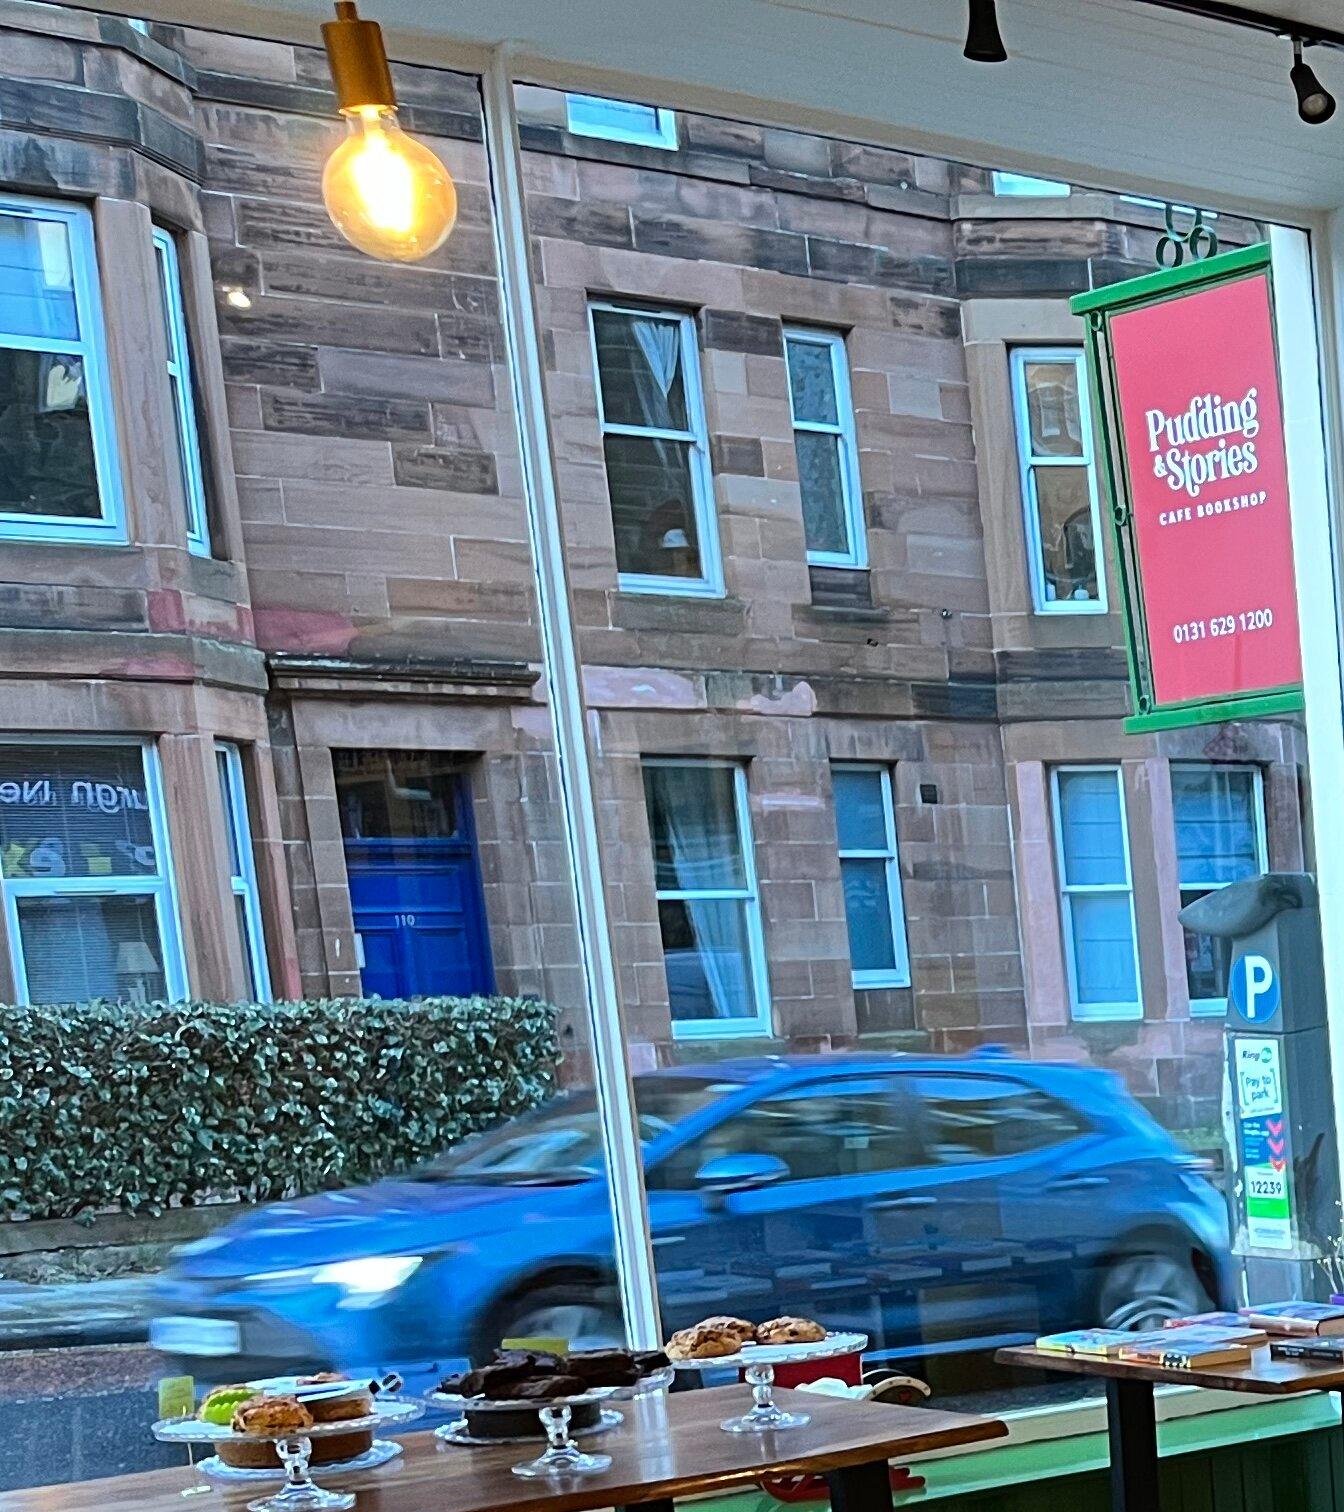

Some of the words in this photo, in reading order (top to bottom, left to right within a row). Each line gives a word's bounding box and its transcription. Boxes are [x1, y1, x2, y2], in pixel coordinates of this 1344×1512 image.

[1145, 387, 1259, 453] Pudding
[1159, 508, 1191, 525] CAFE
[1197, 492, 1267, 518] BOOKSHOP
[1173, 620, 1206, 644] 0131
[1210, 616, 1235, 635] 629
[1239, 609, 1273, 632] 1200
[395, 915, 415, 928] 110
[1244, 956, 1273, 1018] P
[1251, 1181, 1282, 1195] 12239
